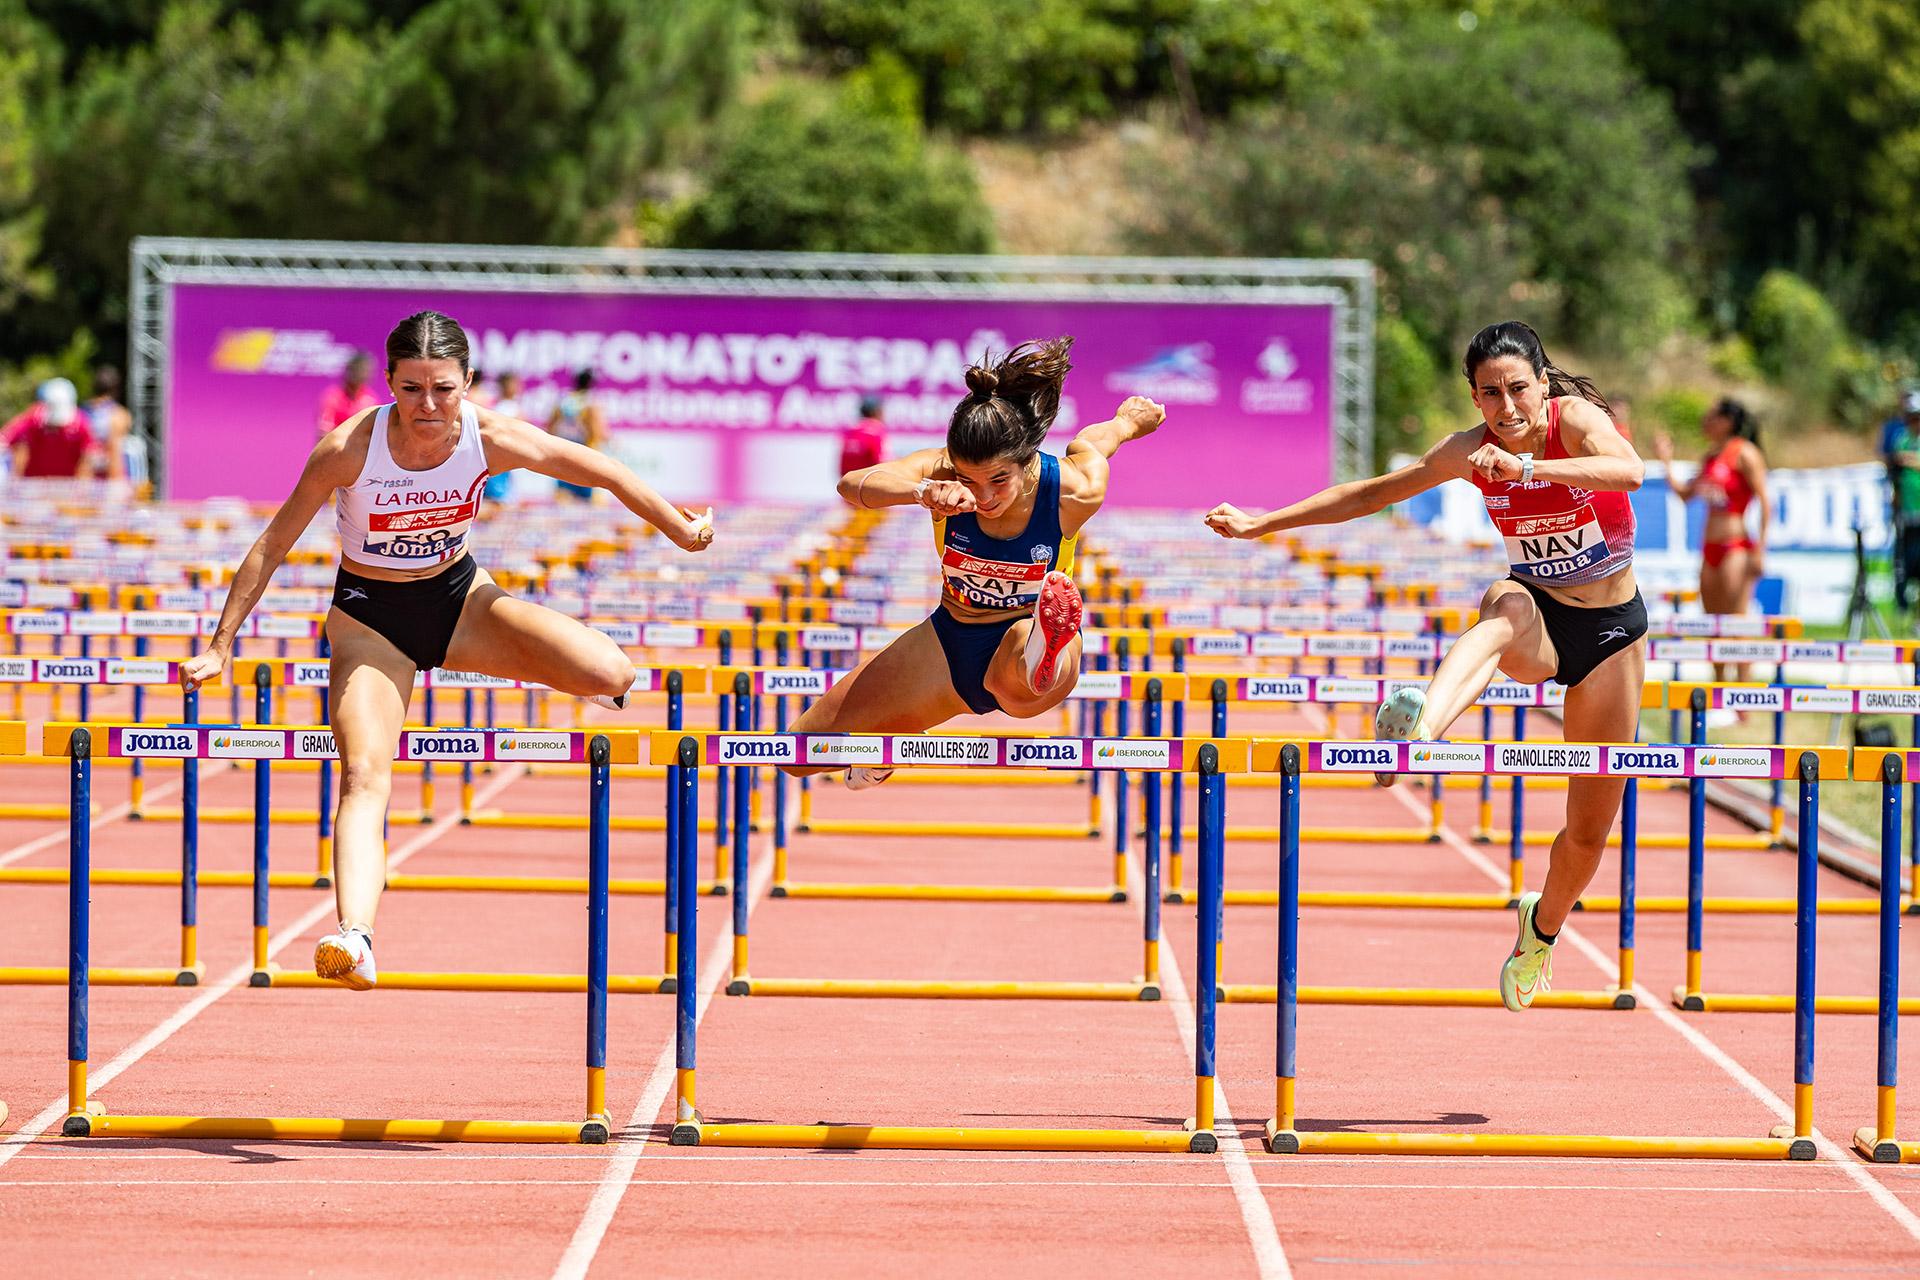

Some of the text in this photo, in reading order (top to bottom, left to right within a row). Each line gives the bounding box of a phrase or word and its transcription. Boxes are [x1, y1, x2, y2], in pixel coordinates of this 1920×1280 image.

[467, 328, 804, 386] MPEONATO
[375, 489, 462, 506] LA RIOJA
[1537, 514, 1577, 527] RFEA
[380, 540, 446, 556] Joma
[1520, 528, 1585, 561] NAV
[983, 562, 1029, 574] RFEA
[42, 664, 95, 678] Joma
[768, 673, 820, 688] Joma
[1252, 681, 1304, 695] Joma
[1726, 692, 1779, 706] Joma
[1866, 693, 1917, 708] GRANOLLERS
[126, 734, 193, 751] Joma
[232, 739, 281, 748] IBERDROLA
[302, 735, 337, 753] GRANO
[412, 737, 480, 756] Joma
[518, 741, 567, 750] IBERDROLA
[723, 741, 791, 759] Joma
[830, 745, 880, 754] IBERDROLA
[900, 741, 989, 760] GRANOLLERS 2022
[1010, 744, 1078, 761] Joma
[1116, 749, 1166, 758] IBERDROLA
[1326, 748, 1393, 766] Joma
[1432, 752, 1482, 761] IBERDROLA
[1502, 749, 1591, 768] GRANOLLERS 2022
[1612, 752, 1680, 770] Joma
[1718, 757, 1767, 766] IBERDROLA
